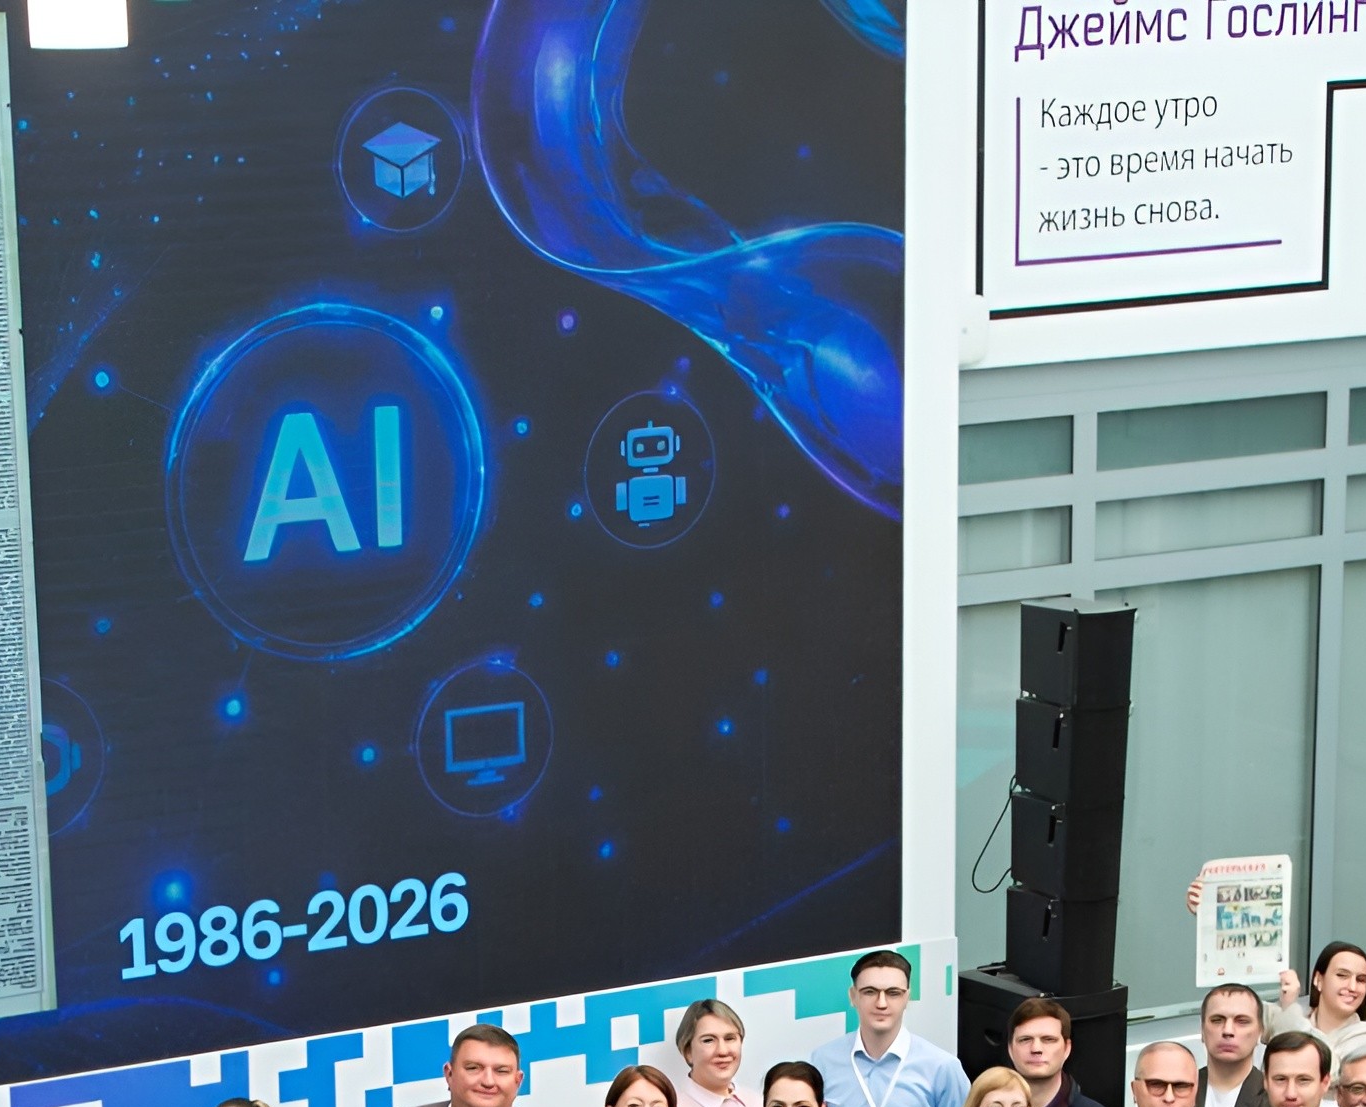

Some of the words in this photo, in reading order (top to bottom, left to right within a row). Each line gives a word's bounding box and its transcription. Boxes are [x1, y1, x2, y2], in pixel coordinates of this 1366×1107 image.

[1014, 0, 1188, 62] Джеймс
[1041, 97, 1147, 131] Каждое
[1154, 95, 1218, 129] утро
[1056, 155, 1101, 180] это
[1110, 148, 1195, 182] время
[1204, 143, 1293, 169] начать
[1038, 206, 1126, 233] жизнь
[1134, 198, 1220, 225] снова.
[243, 405, 403, 562] AI
[119, 872, 469, 980] 1986-2026
